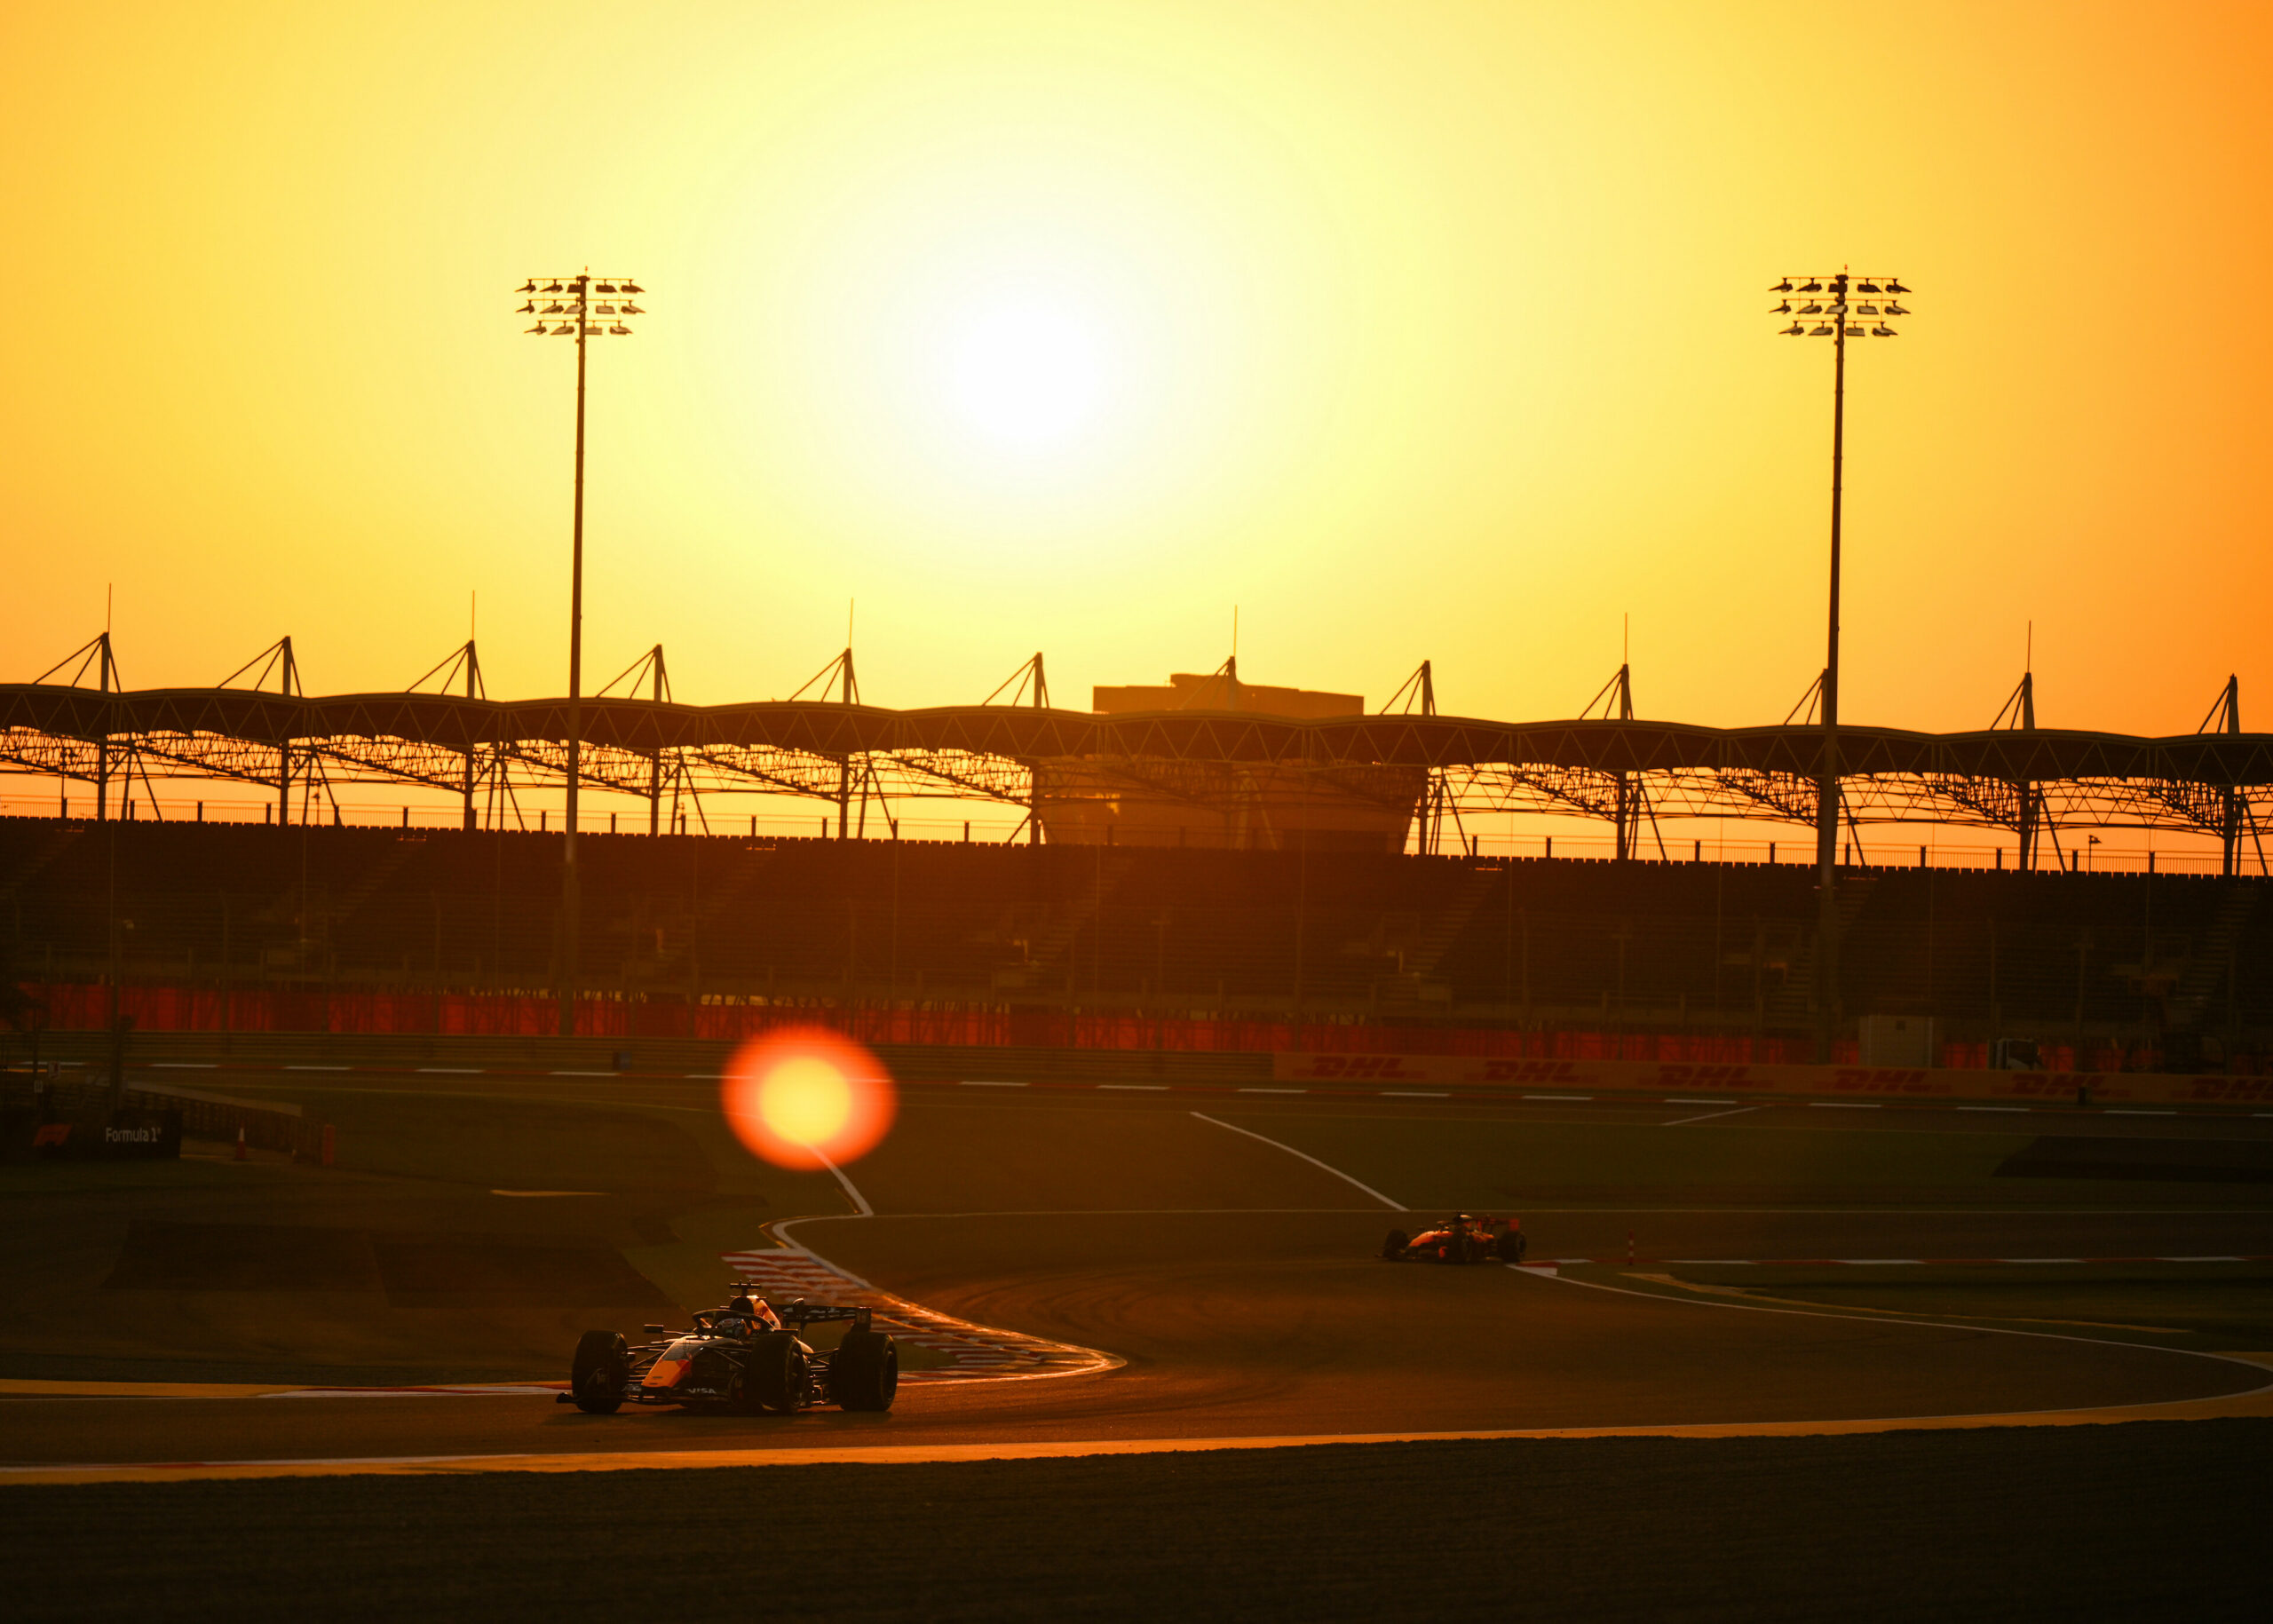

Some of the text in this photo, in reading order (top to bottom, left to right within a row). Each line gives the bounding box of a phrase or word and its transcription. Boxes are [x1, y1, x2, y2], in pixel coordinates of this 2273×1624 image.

[1311, 1056, 1406, 1079] DHL
[1484, 1060, 1580, 1082] DHL
[1658, 1065, 1754, 1087] DHL
[1833, 1069, 1932, 1092] DHL
[2011, 1074, 2110, 1096] DHL
[2191, 1078, 2273, 1100] DH
[105, 1126, 149, 1144] Formula
